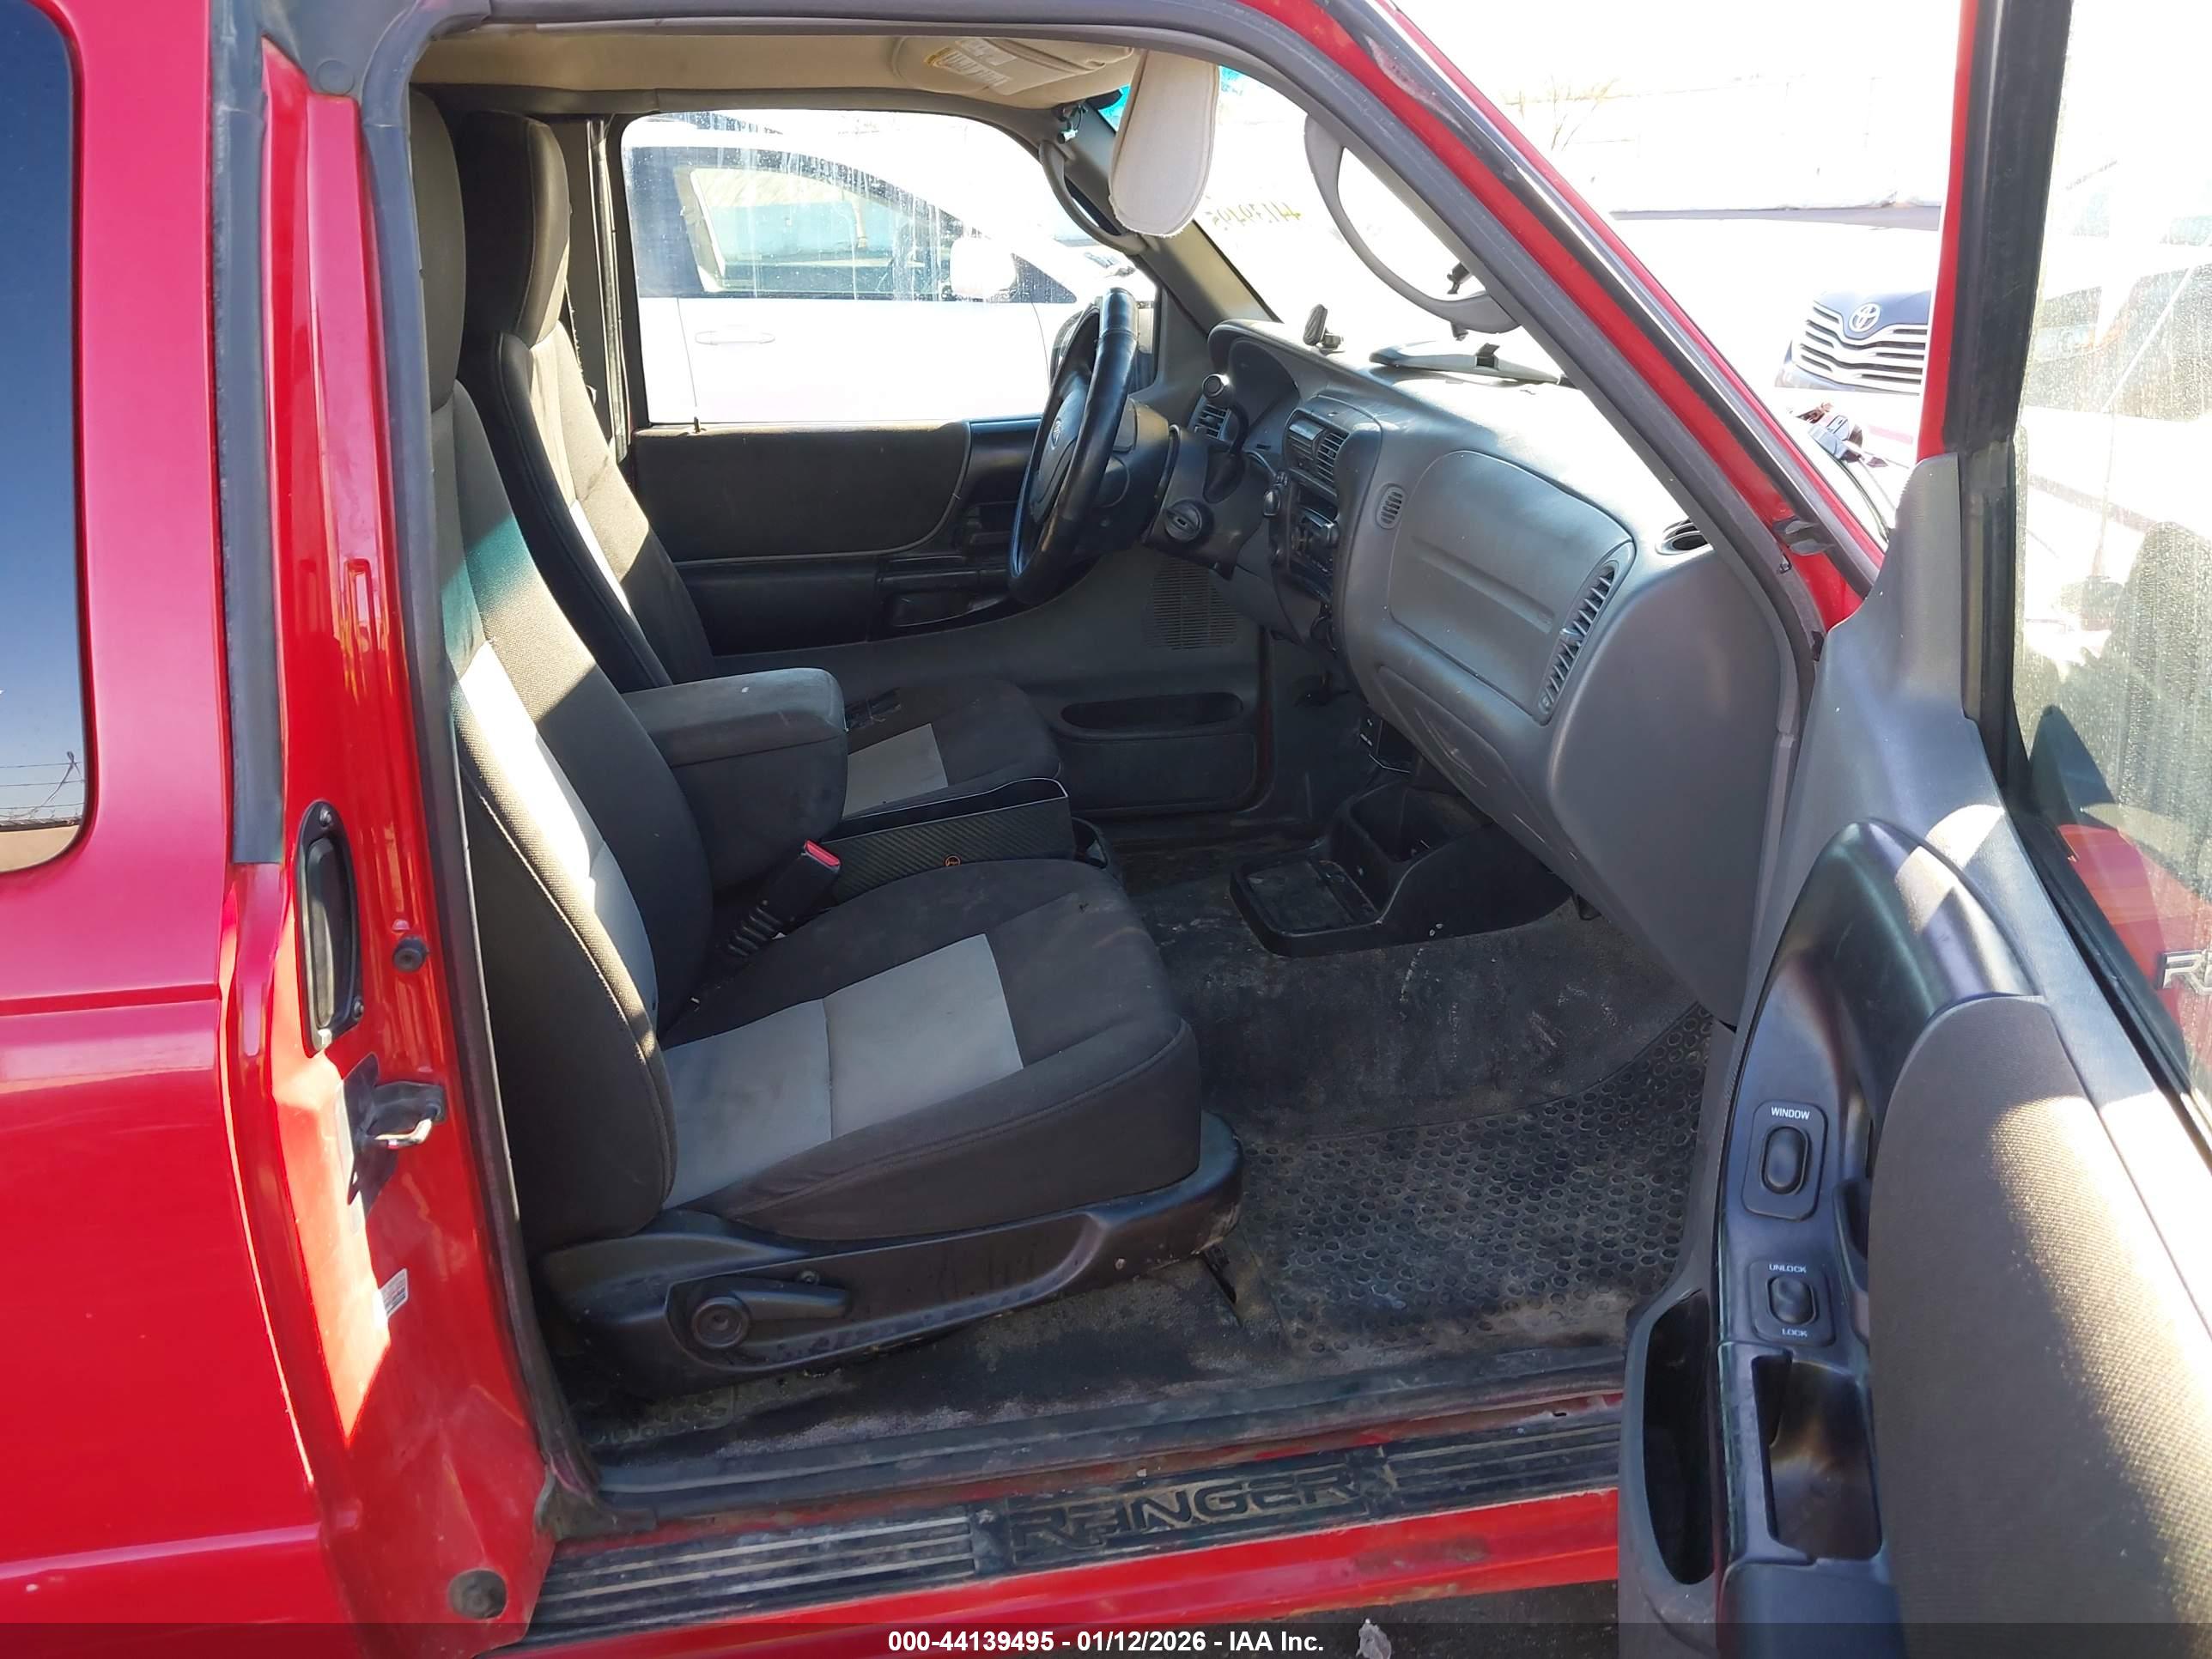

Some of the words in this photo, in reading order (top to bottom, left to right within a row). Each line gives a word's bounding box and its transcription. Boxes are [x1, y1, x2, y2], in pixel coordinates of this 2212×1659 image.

[1771, 1106, 1811, 1121] WINDOW
[1769, 1263, 1807, 1273] UNLOCK
[1781, 1328, 1808, 1338] LOCK
[1012, 1468, 1359, 1553] RANGER
